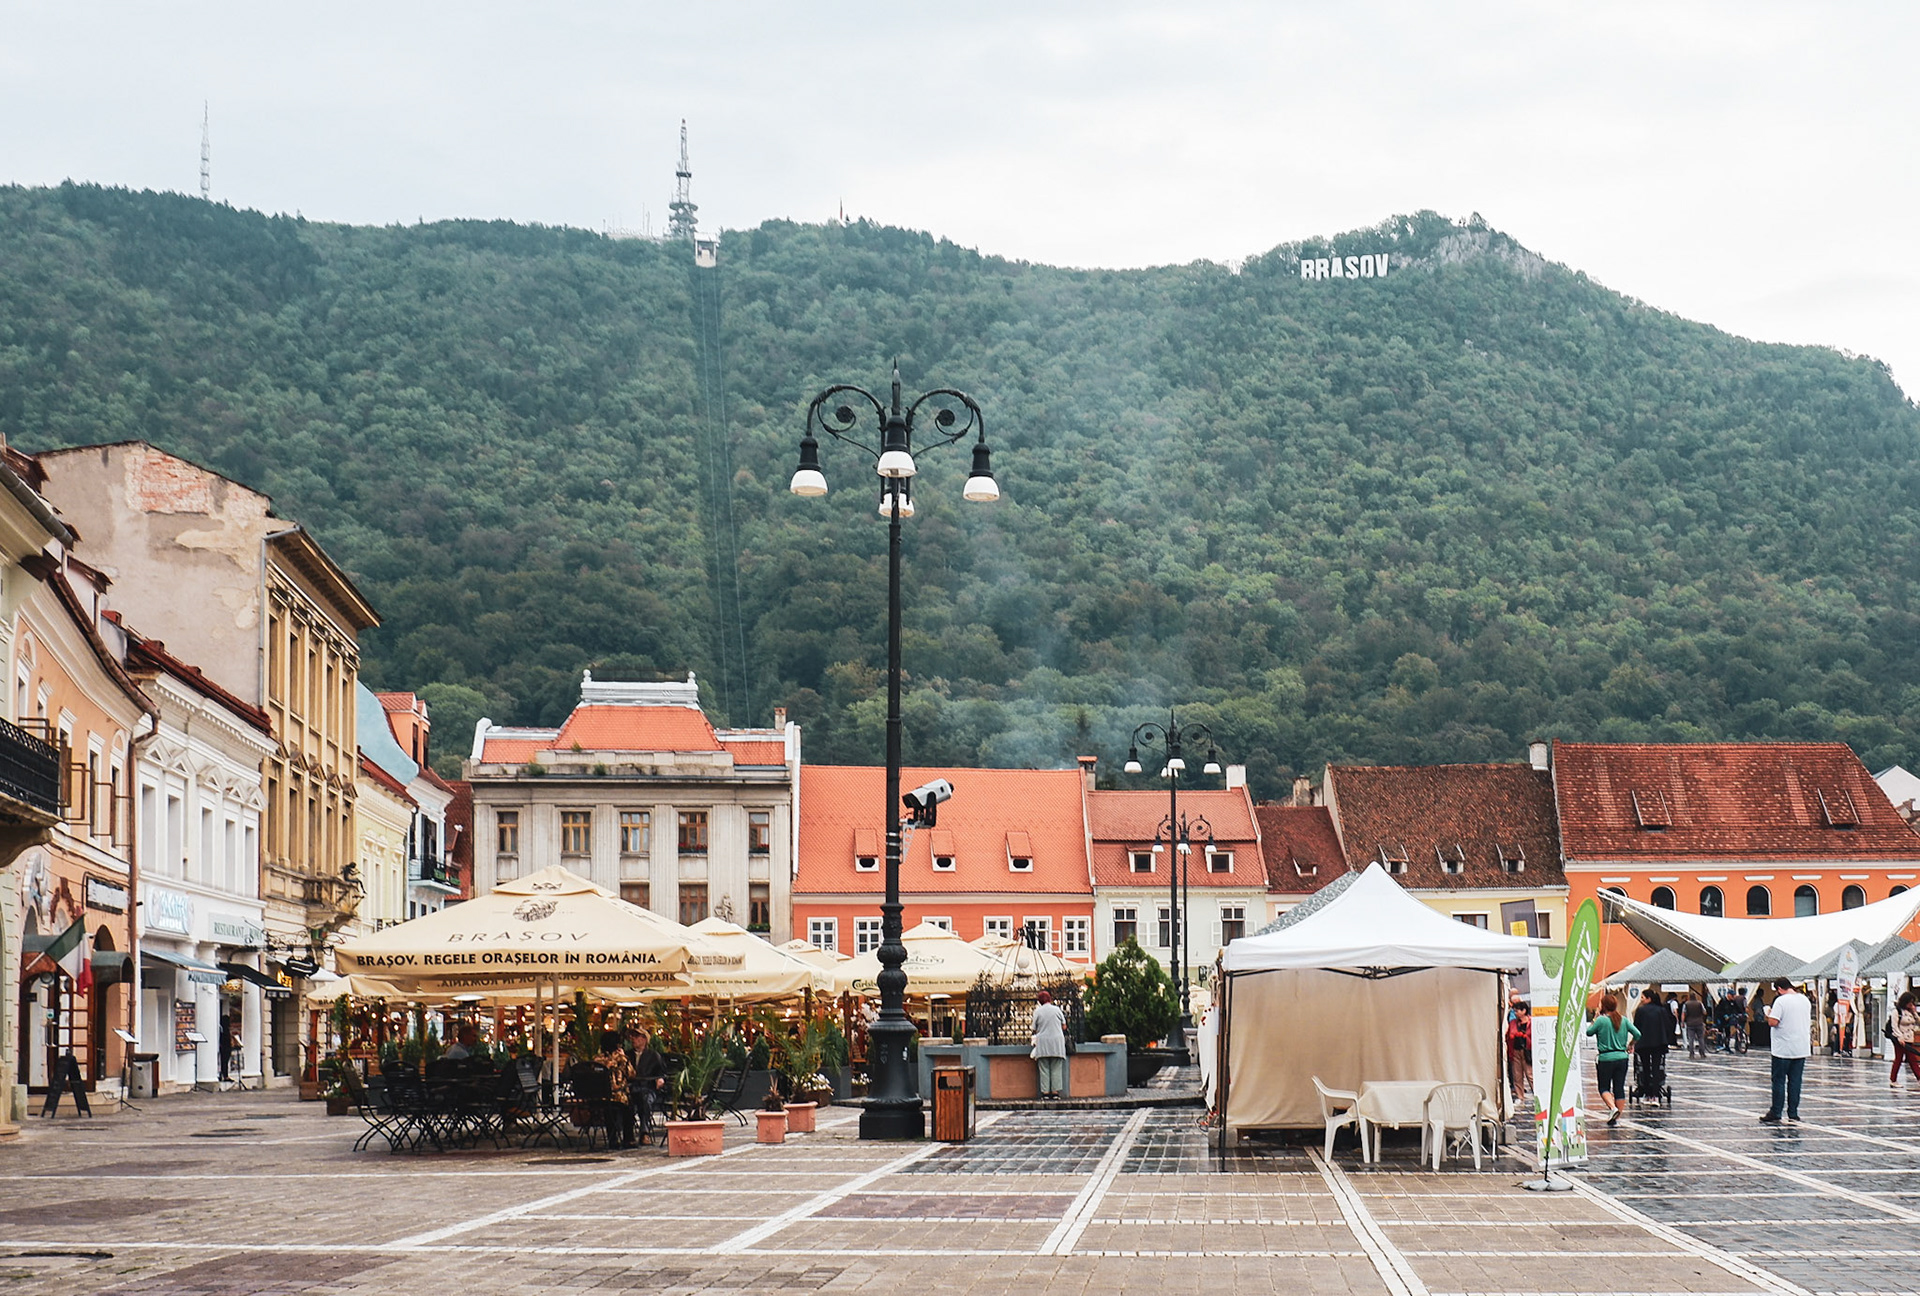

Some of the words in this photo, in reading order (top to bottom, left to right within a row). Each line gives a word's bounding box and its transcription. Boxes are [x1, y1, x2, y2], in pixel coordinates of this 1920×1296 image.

[1300, 253, 1388, 281] BRASOV
[423, 953, 476, 965] REGELE
[481, 952, 559, 966] ORAȘELOR
[564, 950, 580, 964] ÎN
[586, 950, 661, 964] ROMÂNIA.
[1570, 930, 1592, 1011] FOV
